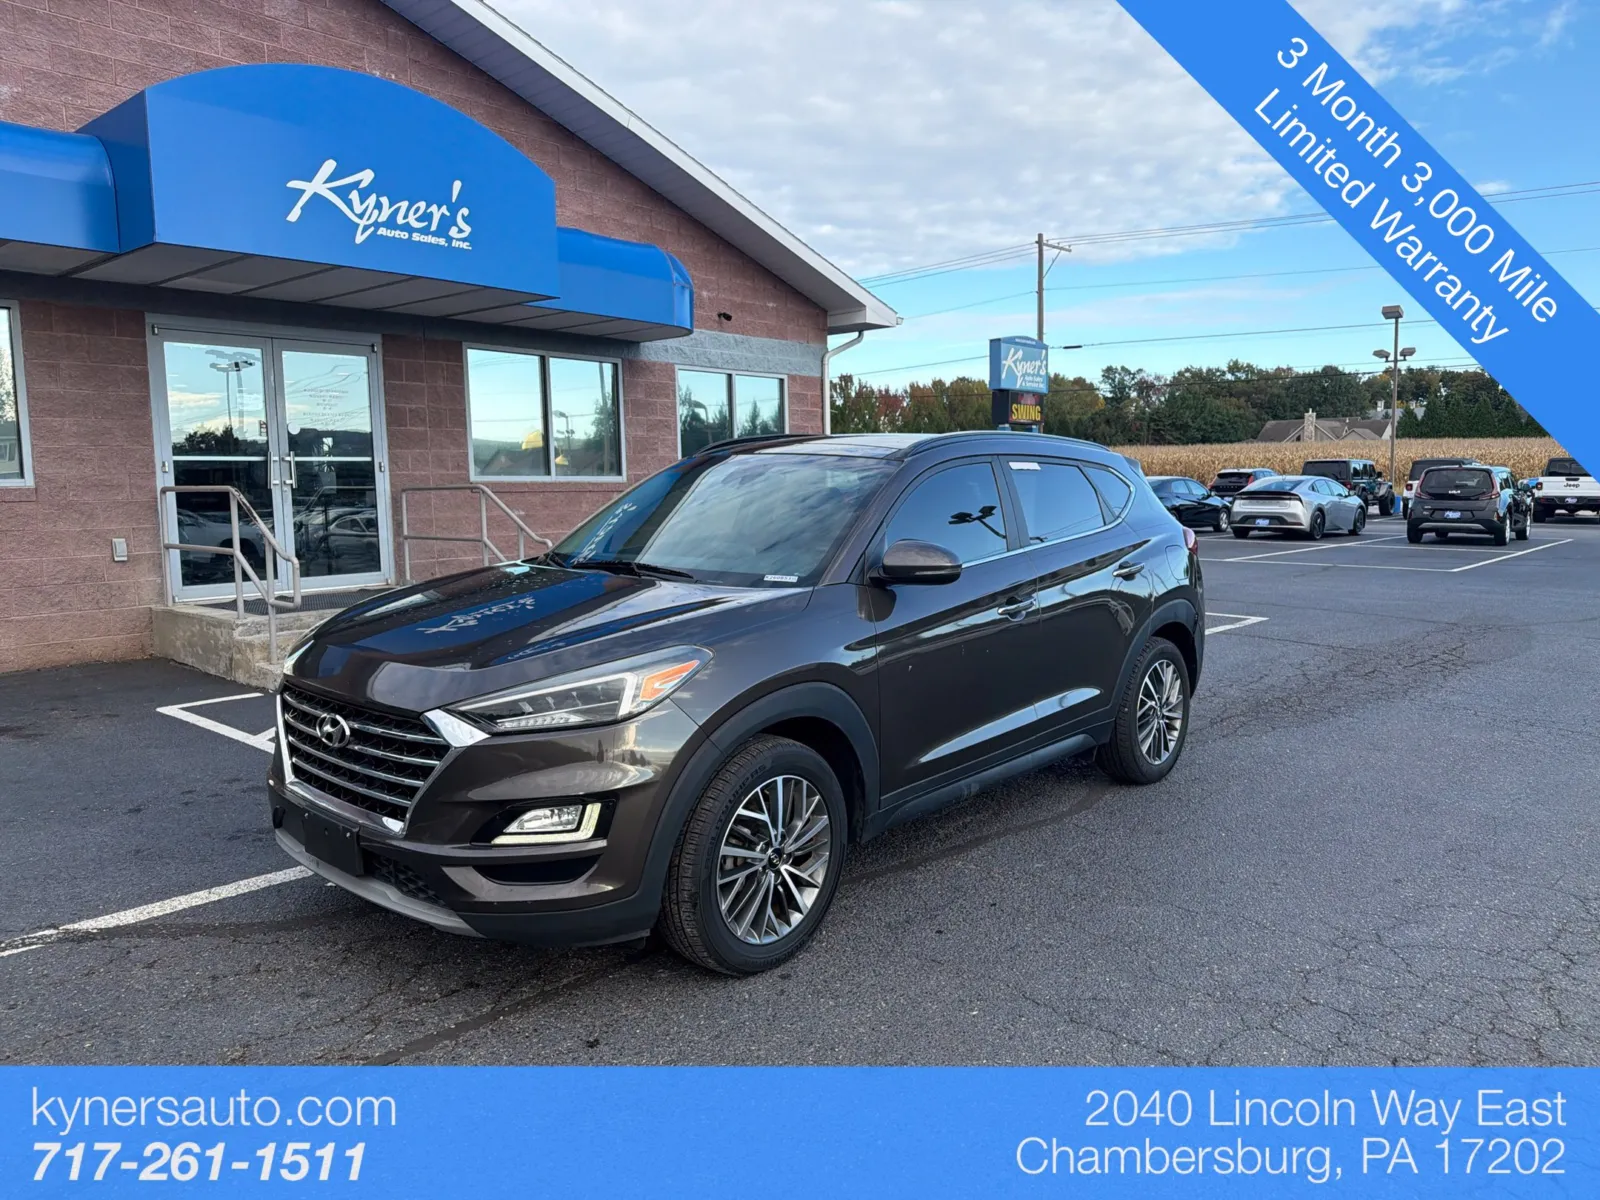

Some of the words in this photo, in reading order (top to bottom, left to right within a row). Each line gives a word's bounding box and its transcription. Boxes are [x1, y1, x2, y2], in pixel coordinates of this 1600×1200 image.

[285, 158, 472, 245] Kyner's
[376, 226, 409, 240] Auto
[411, 232, 449, 248] Sales,
[1002, 347, 1046, 388] Kyner's
[1012, 404, 1041, 420] SWING
